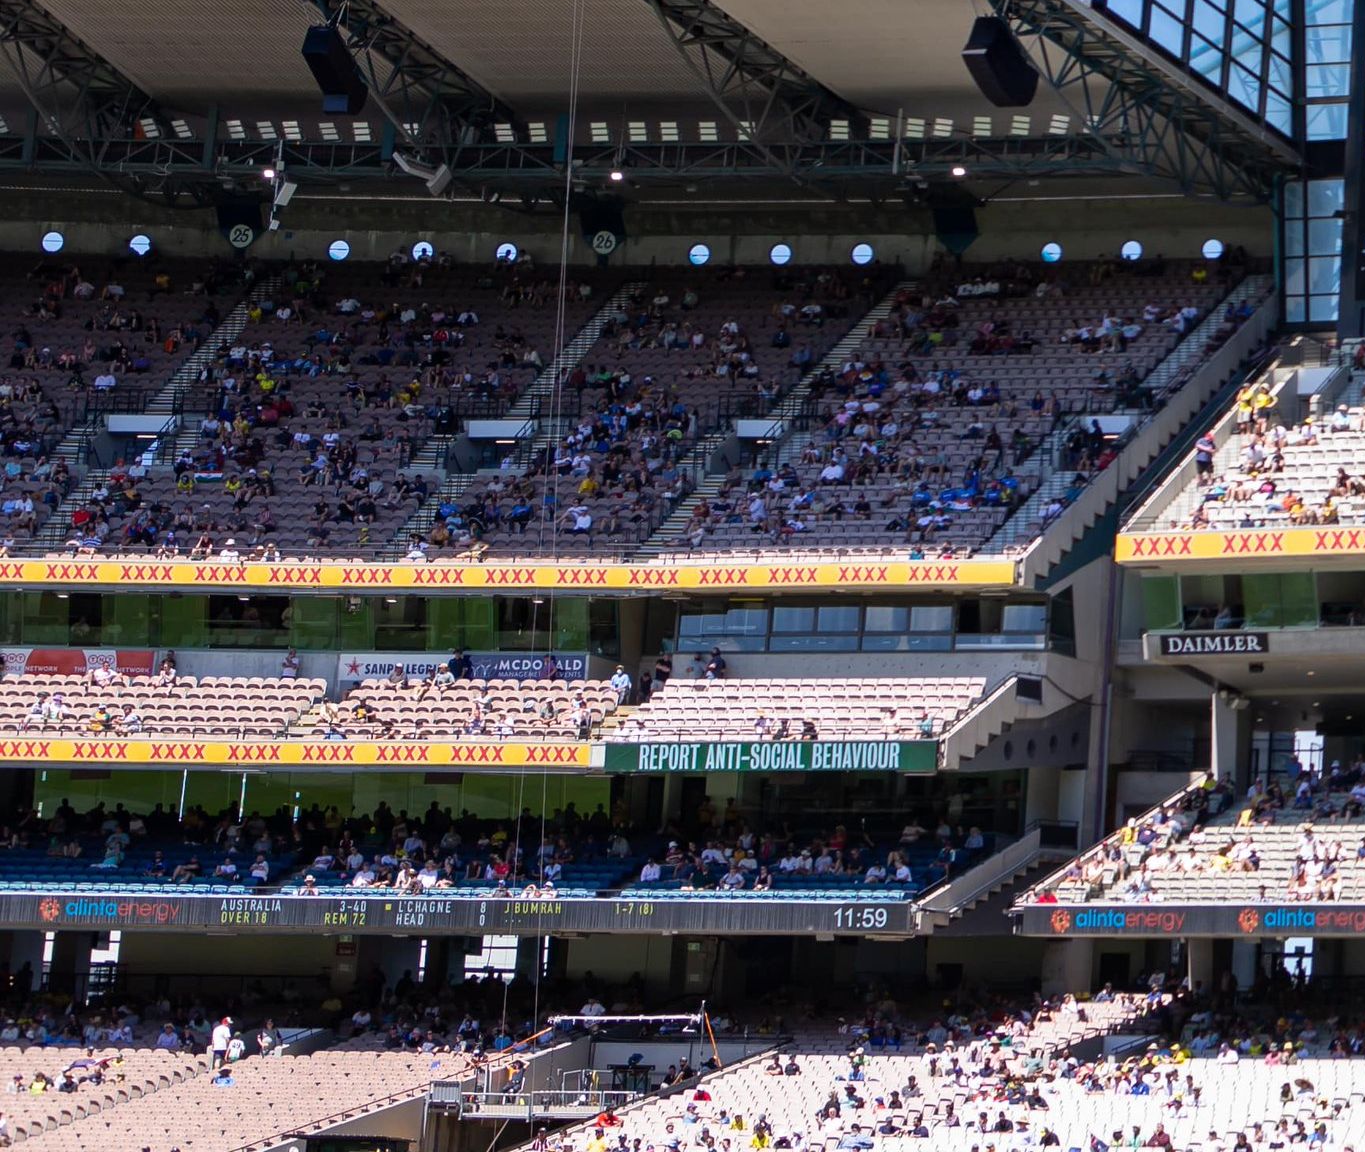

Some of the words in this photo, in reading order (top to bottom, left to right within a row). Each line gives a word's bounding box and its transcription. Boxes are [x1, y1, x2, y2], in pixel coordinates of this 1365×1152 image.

[1132, 537, 1192, 556] XXXX
[1223, 533, 1283, 553] XXXX
[0, 564, 25, 579] XX
[46, 564, 98, 579] XXXX
[121, 565, 173, 580] XXXX
[194, 566, 247, 581] XXXX
[270, 567, 321, 583] XXXX
[342, 568, 392, 583] XXXX
[413, 568, 464, 583] XXXX
[485, 568, 536, 583] XXXX
[557, 568, 607, 583] XXXX
[628, 569, 679, 584] XXXX
[699, 568, 748, 584] XXXX
[768, 567, 818, 583] XXXX
[838, 566, 888, 582] XXXX
[908, 566, 959, 581] XXXX
[1168, 635, 1262, 653] DAIMLER
[499, 660, 582, 671] MCDOALD
[73, 742, 127, 758] XXXX
[150, 744, 206, 759] XXXX
[228, 744, 280, 760] XXXX
[302, 745, 354, 761] XXXX
[376, 745, 429, 761] XXXX
[451, 745, 503, 762] XXXX
[526, 746, 578, 762] XXXX
[639, 743, 700, 770] REPORT
[705, 743, 804, 770] ANTI-SOCIAL
[812, 742, 900, 769] BEHAVIOUR
[220, 899, 281, 912] AUSTRALIA
[339, 901, 367, 913] 3-40
[398, 900, 451, 914] L'CHAGNE
[480, 902, 487, 913] 8
[504, 902, 510, 914] J
[514, 902, 562, 914] BUMRAH
[615, 903, 634, 914] 1-7
[639, 902, 654, 915] (8)
[220, 912, 250, 923] OVER
[255, 912, 267, 923] 18
[324, 913, 347, 925] REM
[352, 913, 366, 925] 72
[396, 914, 424, 926] HEAD
[479, 914, 486, 926] 0
[833, 908, 887, 928] 11:59
